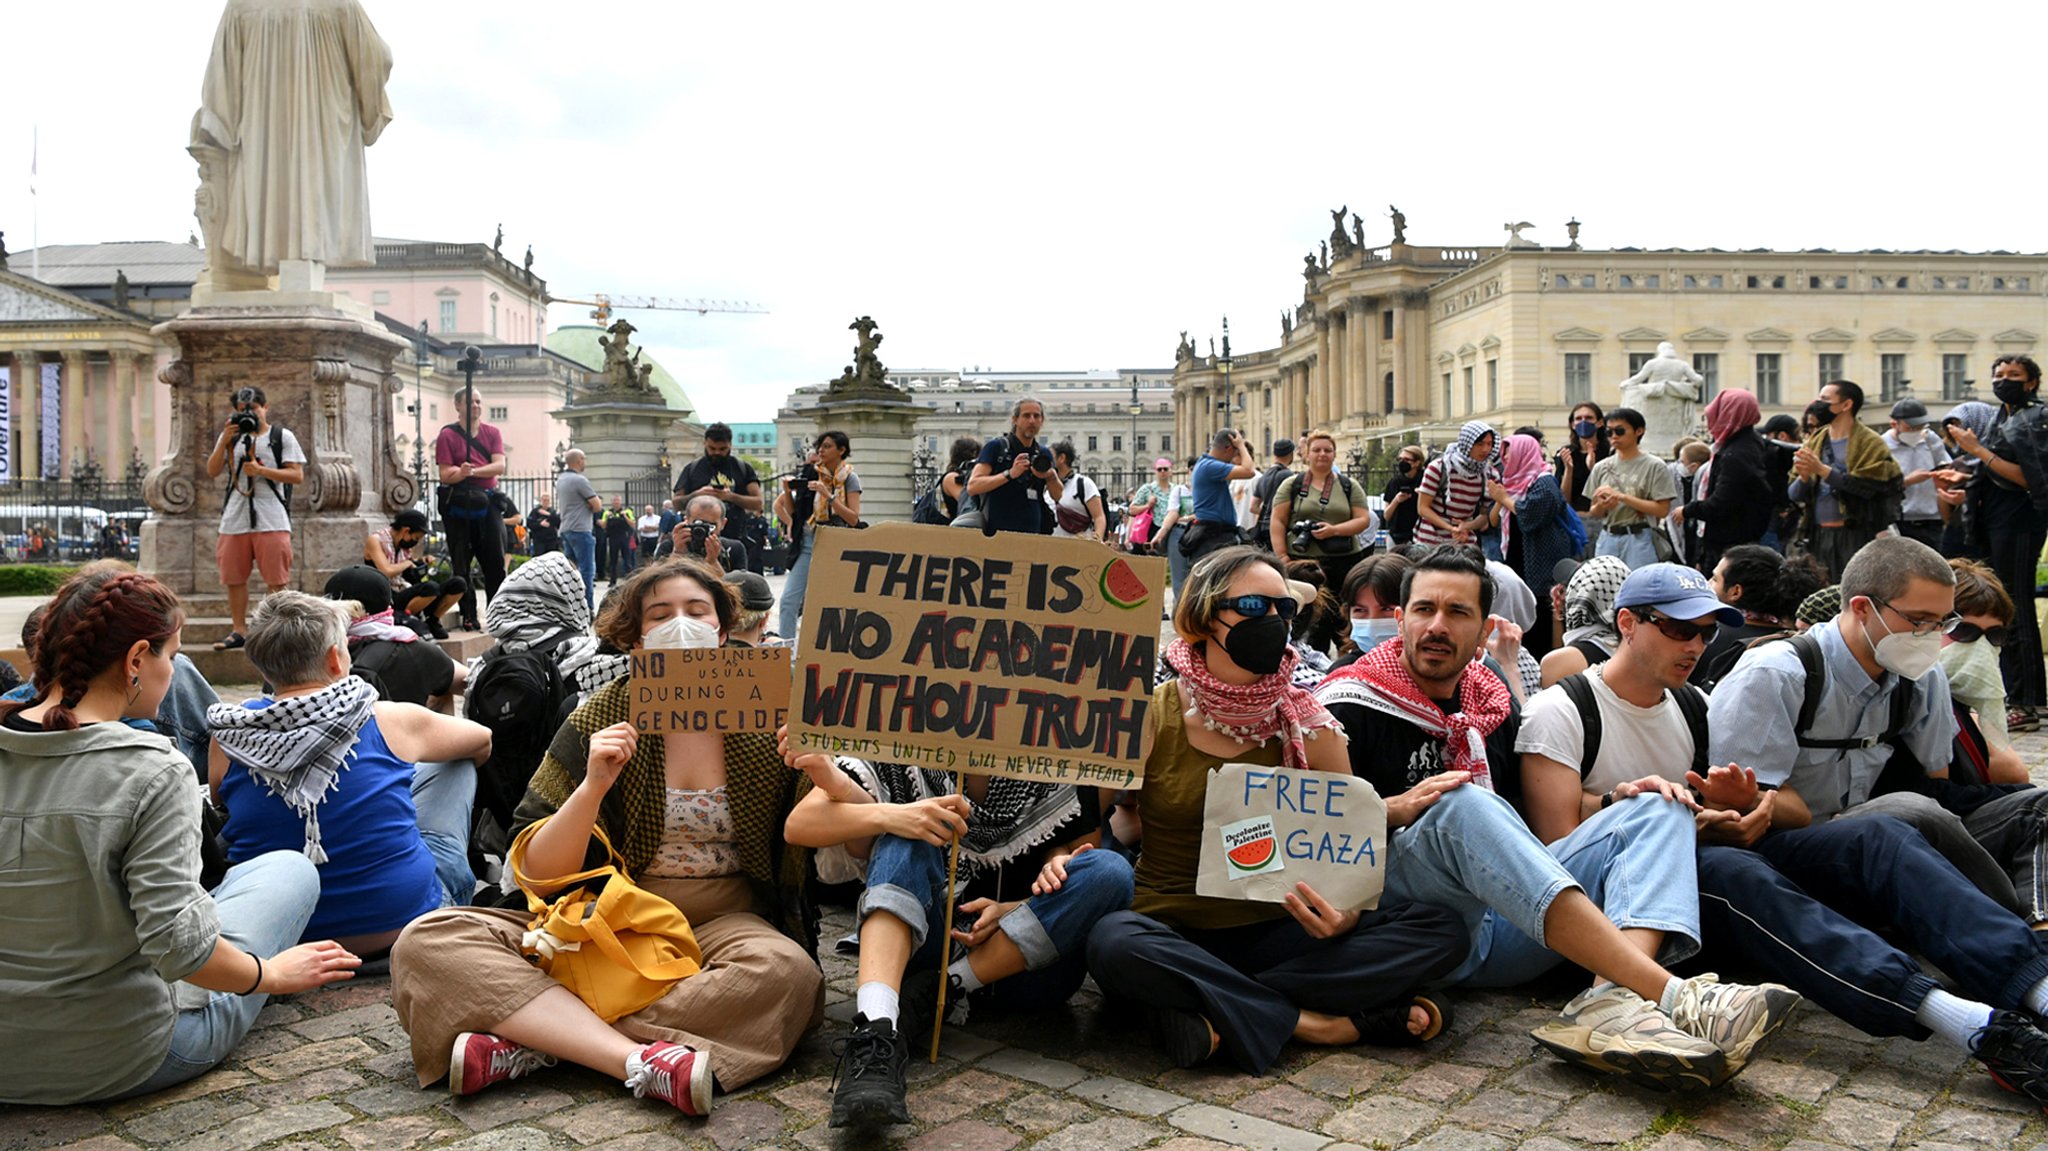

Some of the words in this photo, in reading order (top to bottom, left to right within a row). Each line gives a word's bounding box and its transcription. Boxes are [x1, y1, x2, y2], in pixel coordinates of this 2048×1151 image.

[840, 550, 1013, 610] THERE
[1026, 563, 1083, 613] IS
[632, 652, 665, 679] NO
[682, 649, 780, 664] BUSINESS
[725, 657, 738, 667] AS
[815, 607, 892, 660] NO
[901, 610, 1155, 696] ACADEMIA
[698, 667, 755, 678] USUAL
[640, 685, 725, 703] DURING
[750, 685, 762, 700] A
[636, 708, 788, 731] GENOCIDE
[802, 664, 1010, 740] WITHOUT
[1016, 688, 1148, 760] TRUTH
[801, 732, 880, 755] STUDENTS
[893, 743, 956, 766] UNITED
[968, 751, 996, 769] WILL
[1005, 755, 1052, 778] NEVER
[1056, 759, 1071, 778] BE
[1076, 761, 1135, 788] DEFEATED
[1244, 771, 1348, 817] FREE
[1225, 822, 1271, 843] Decolonize
[1234, 829, 1272, 846] Palestine
[1285, 829, 1375, 867] GAZA
